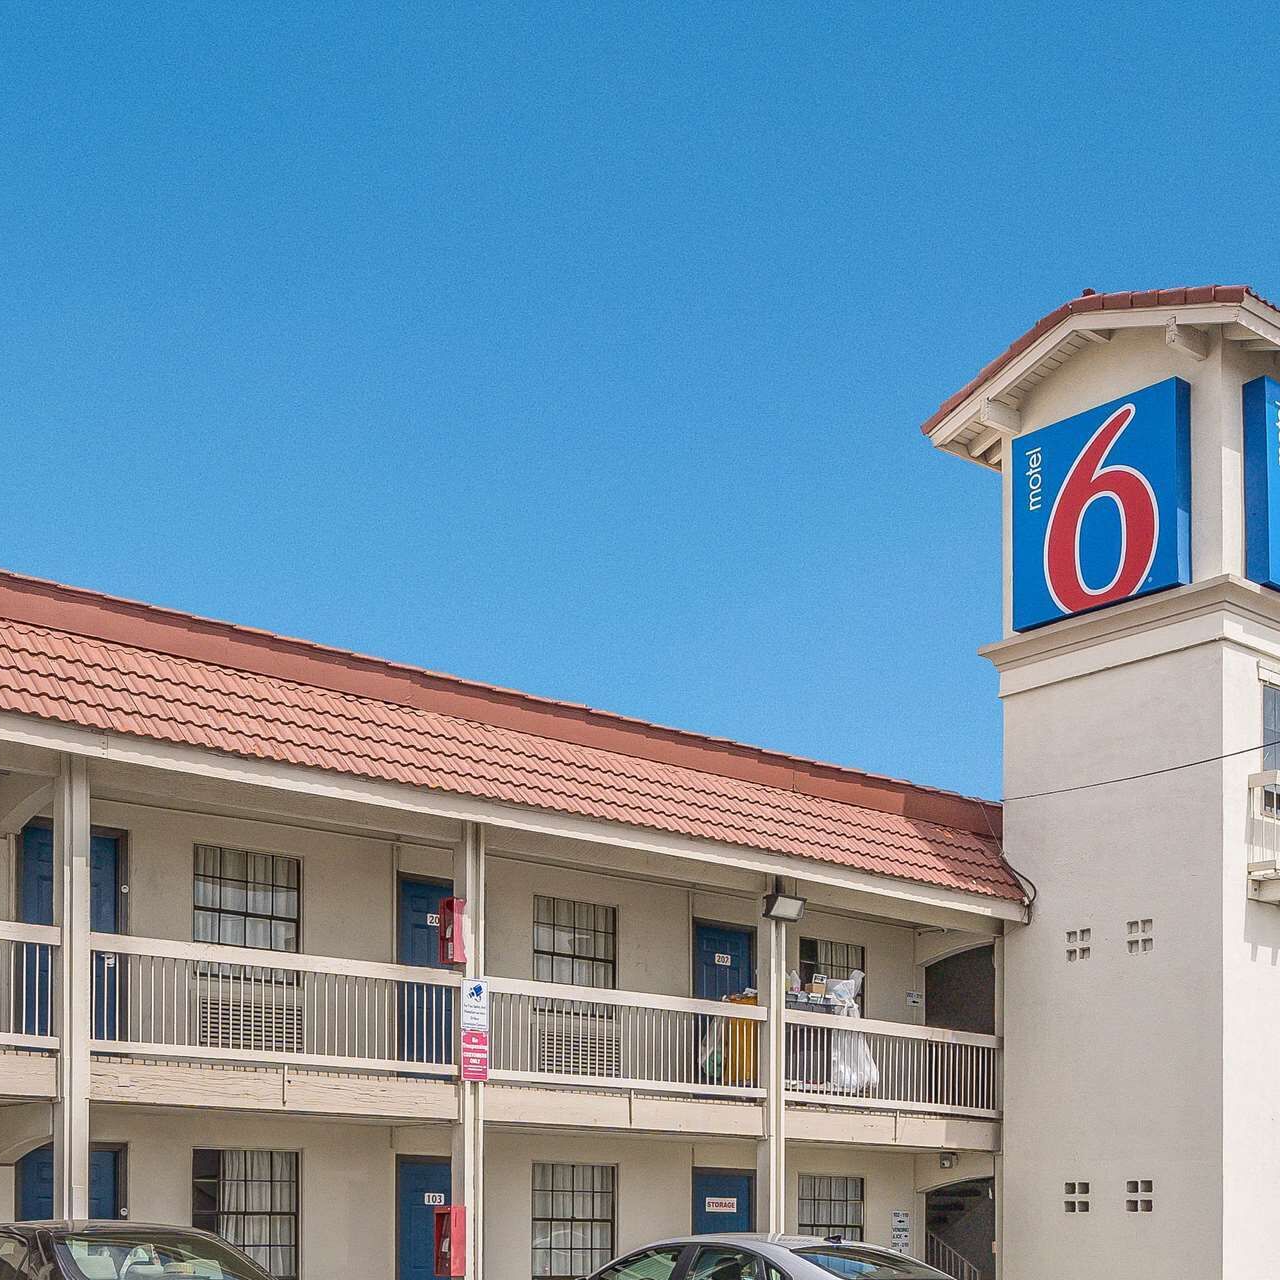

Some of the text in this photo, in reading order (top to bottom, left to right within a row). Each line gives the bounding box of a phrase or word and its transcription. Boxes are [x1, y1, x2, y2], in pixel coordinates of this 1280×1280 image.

[1025, 403, 1160, 614] motel 6
[426, 1194, 442, 1203] 103
